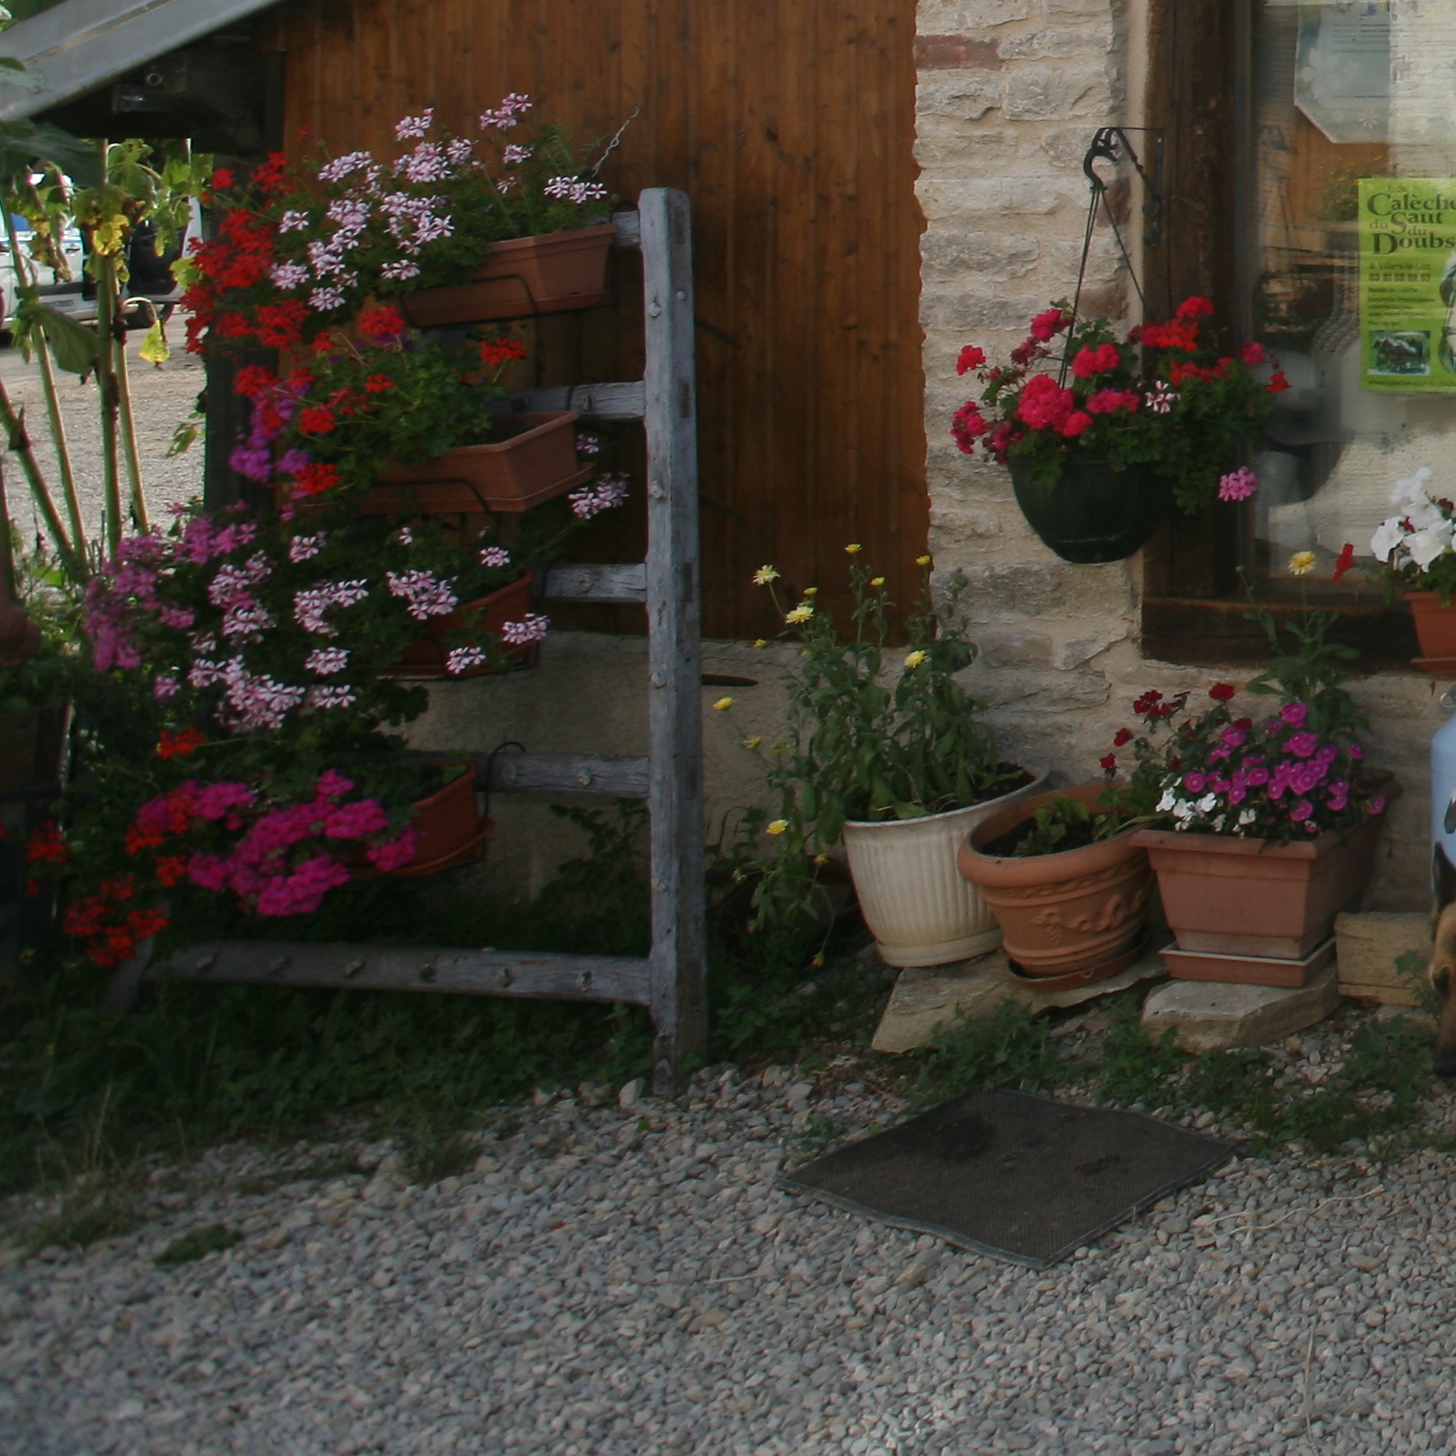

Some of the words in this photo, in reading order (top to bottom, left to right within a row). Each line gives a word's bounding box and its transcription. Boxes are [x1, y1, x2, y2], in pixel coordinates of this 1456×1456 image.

[1369, 219, 1388, 229] du
[1390, 211, 1443, 234] Saut
[1408, 225, 1427, 236] du
[1372, 232, 1456, 255] Doubs
